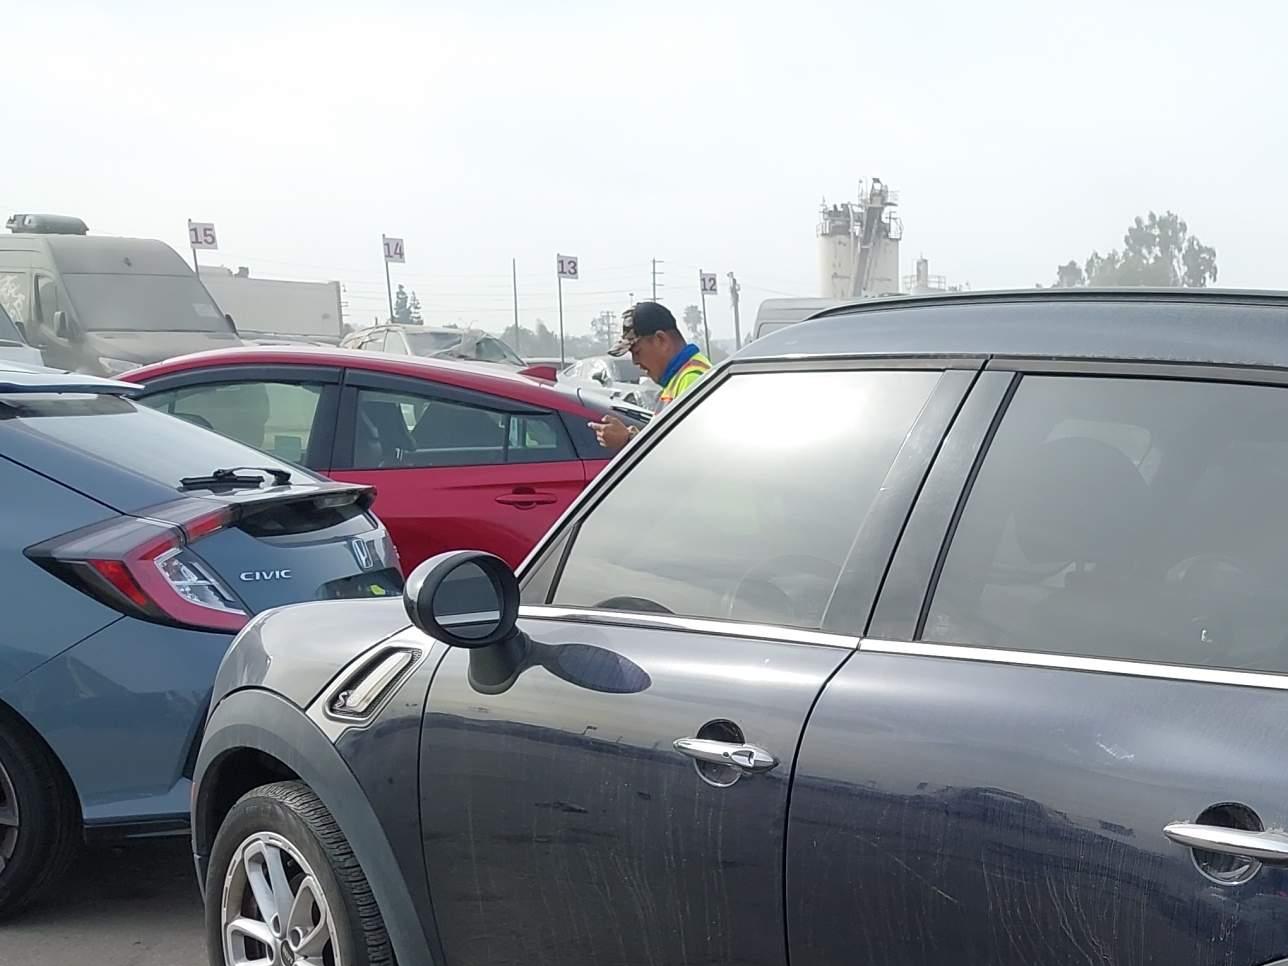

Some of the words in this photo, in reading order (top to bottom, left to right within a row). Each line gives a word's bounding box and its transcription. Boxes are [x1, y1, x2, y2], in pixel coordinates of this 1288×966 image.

[190, 227, 216, 245] 15
[384, 242, 404, 259] 14
[558, 260, 578, 275] 13
[701, 277, 717, 291] 12
[240, 569, 292, 581] CIVIC
